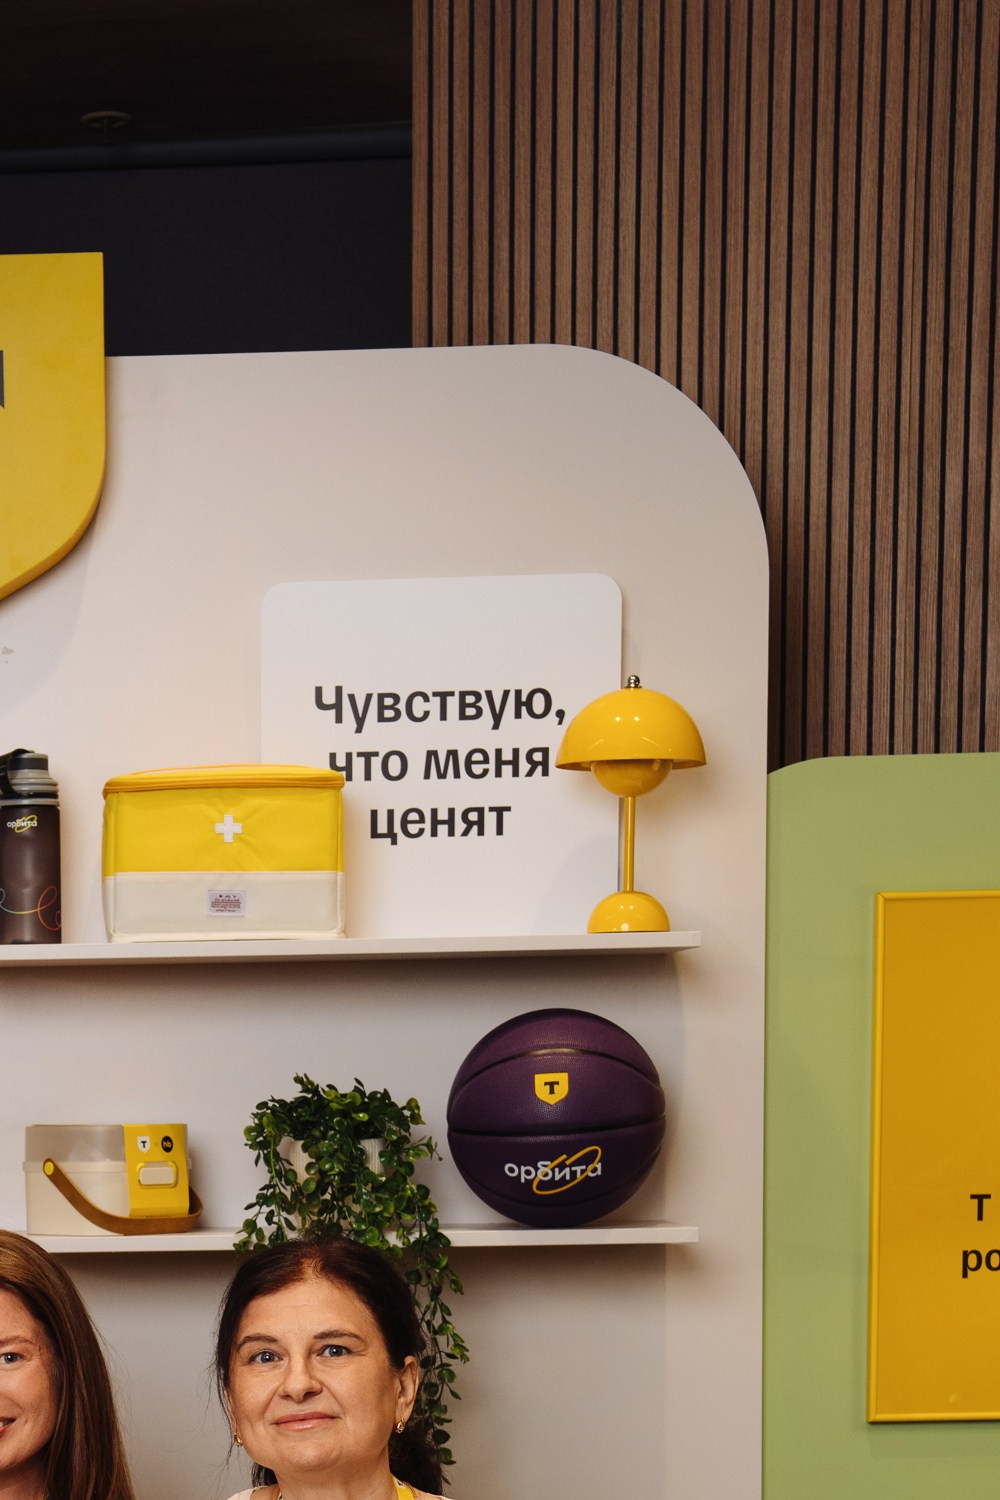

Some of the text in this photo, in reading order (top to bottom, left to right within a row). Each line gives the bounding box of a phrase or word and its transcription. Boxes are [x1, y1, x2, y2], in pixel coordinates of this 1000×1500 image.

[315, 685, 566, 734] Чувствую,
[329, 746, 550, 782] что меня
[370, 806, 512, 846] ценят
[969, 1193, 992, 1222] Т
